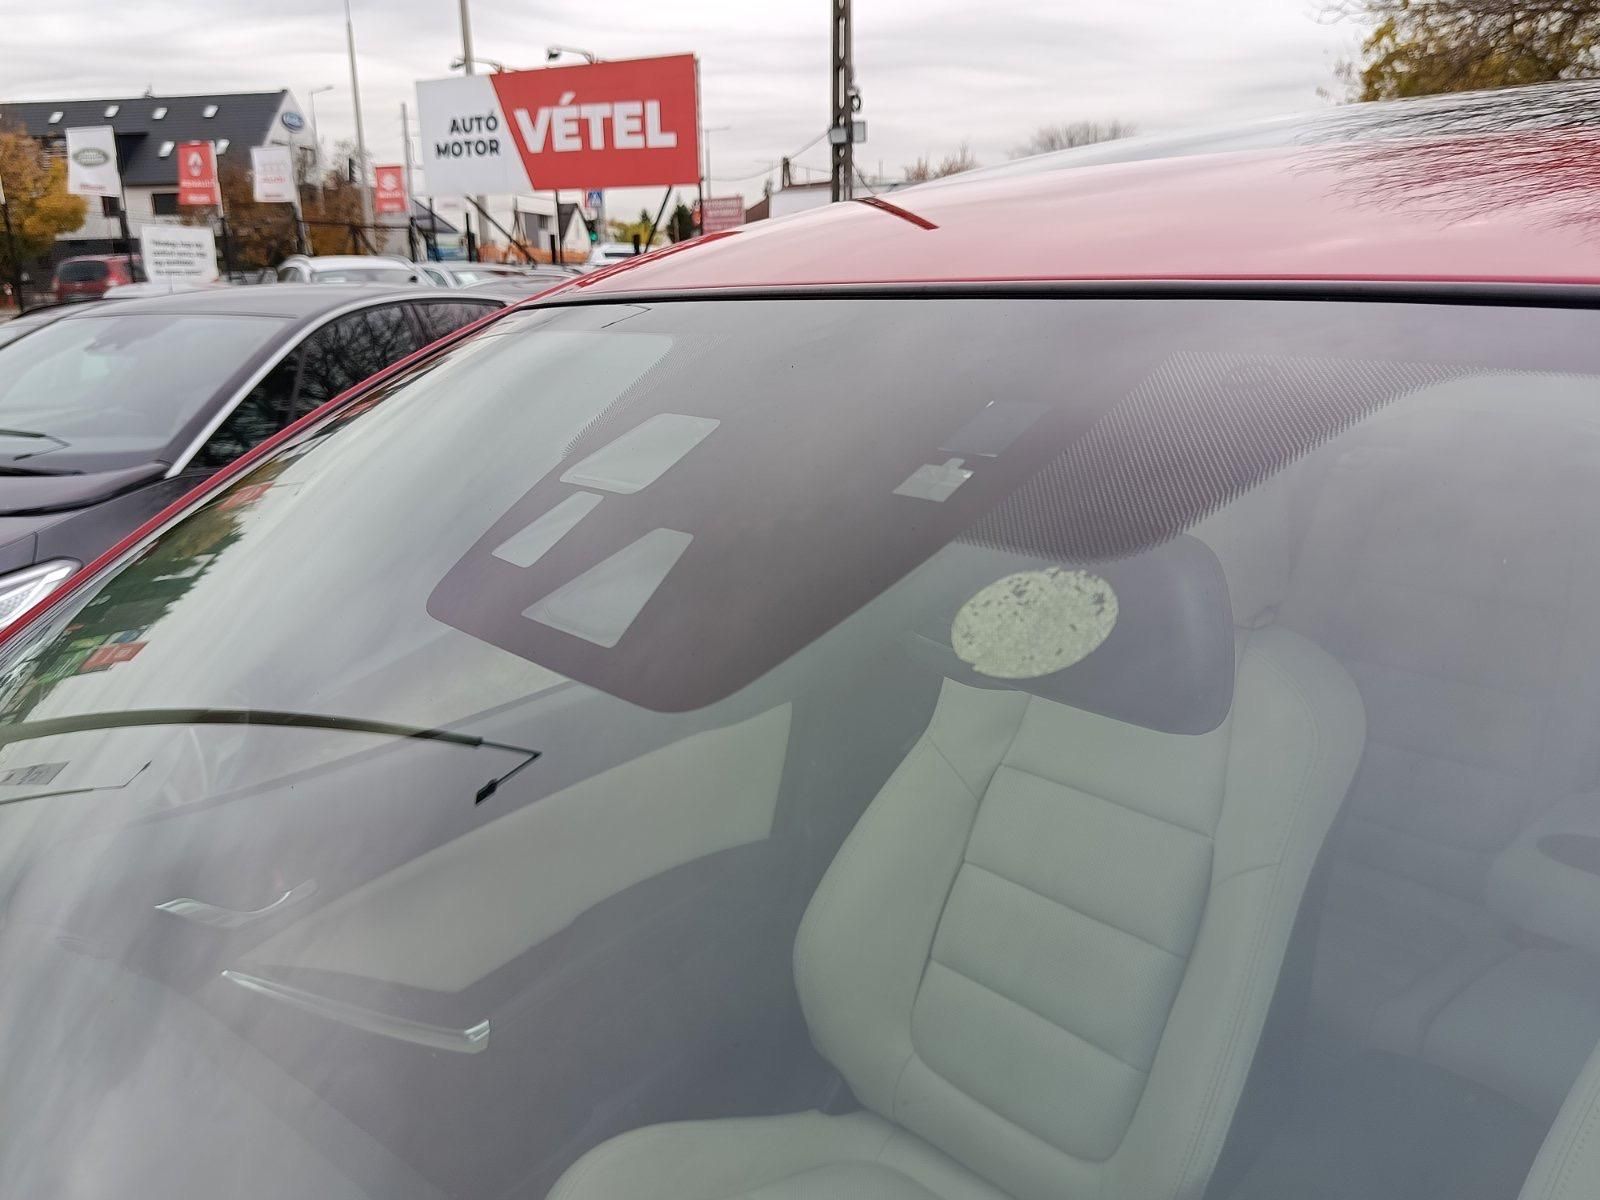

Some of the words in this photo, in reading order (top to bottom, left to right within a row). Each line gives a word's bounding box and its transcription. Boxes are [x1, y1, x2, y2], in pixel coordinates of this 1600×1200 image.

[450, 112, 498, 134] AUTÓ
[513, 92, 677, 154] VÉTEL
[436, 139, 499, 158] MOTOR
